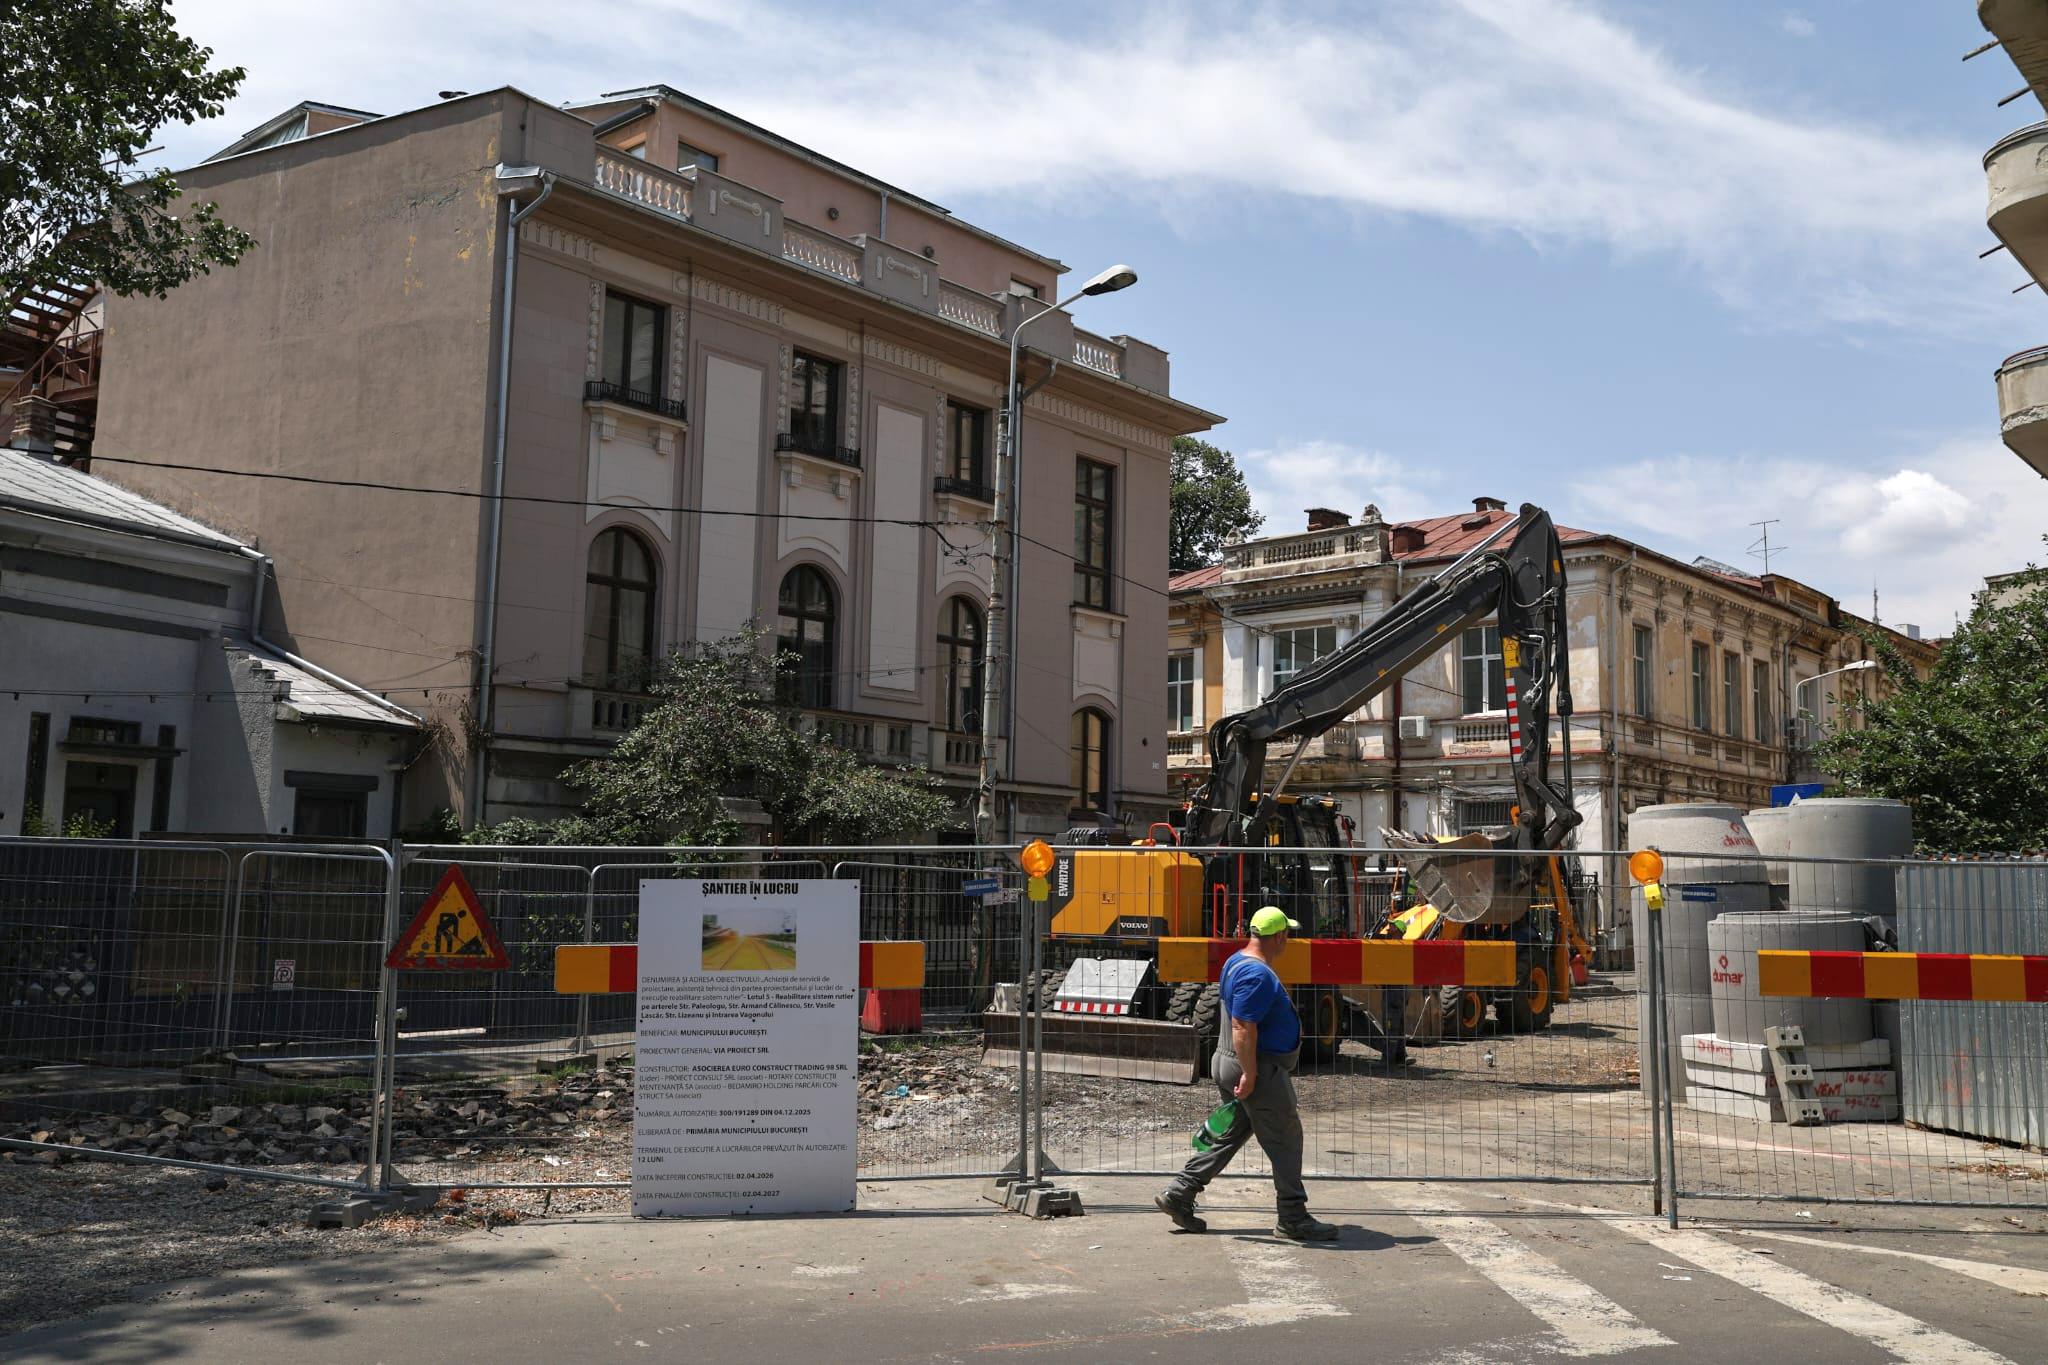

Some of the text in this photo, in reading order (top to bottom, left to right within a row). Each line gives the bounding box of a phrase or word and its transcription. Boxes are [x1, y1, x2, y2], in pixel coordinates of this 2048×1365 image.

[1058, 858, 1069, 897] EWR170E
[702, 880, 799, 897] ȘANTIER ÎN LUCRU
[739, 1011, 774, 1019] Vagonului
